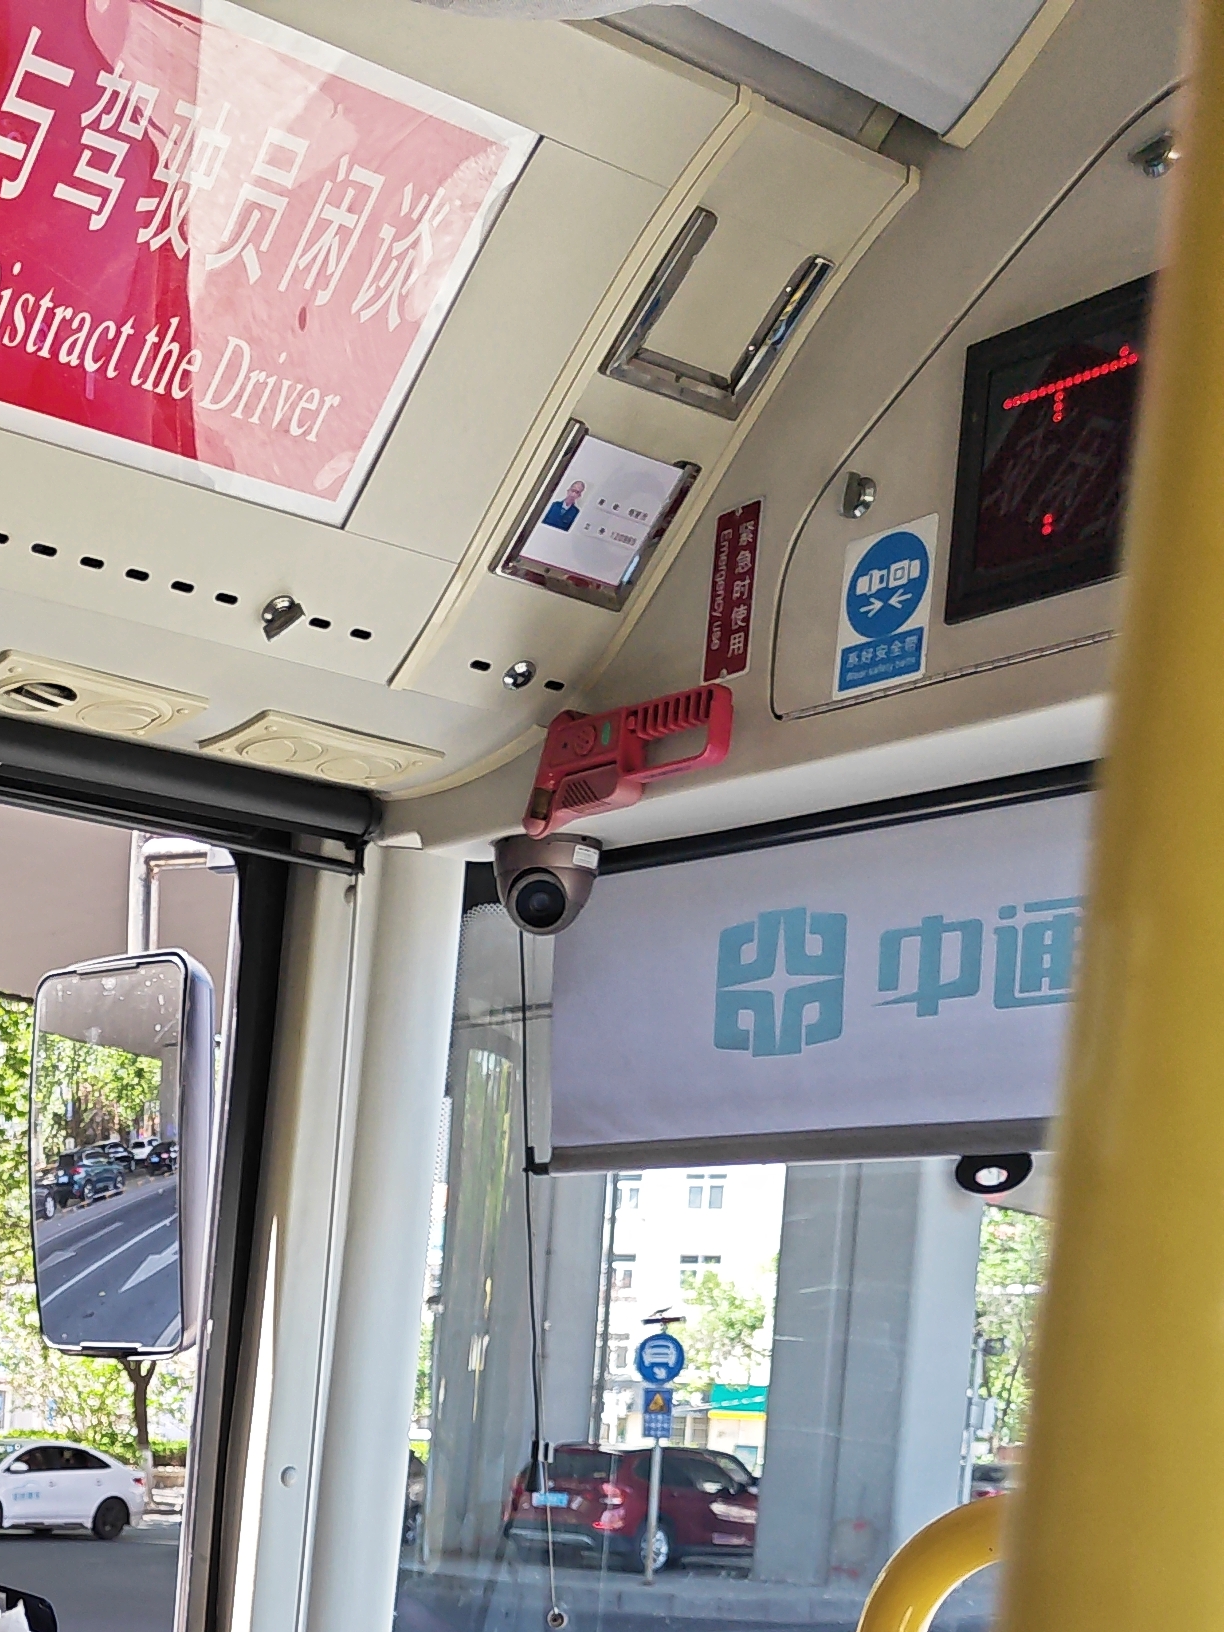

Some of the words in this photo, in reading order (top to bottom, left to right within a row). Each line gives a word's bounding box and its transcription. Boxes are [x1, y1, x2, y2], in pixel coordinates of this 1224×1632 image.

[130, 316, 203, 400] the
[198, 336, 342, 442] Driver
[711, 527, 734, 618] Emergency
[727, 519, 756, 658] 紧急时使用
[709, 620, 723, 651] use
